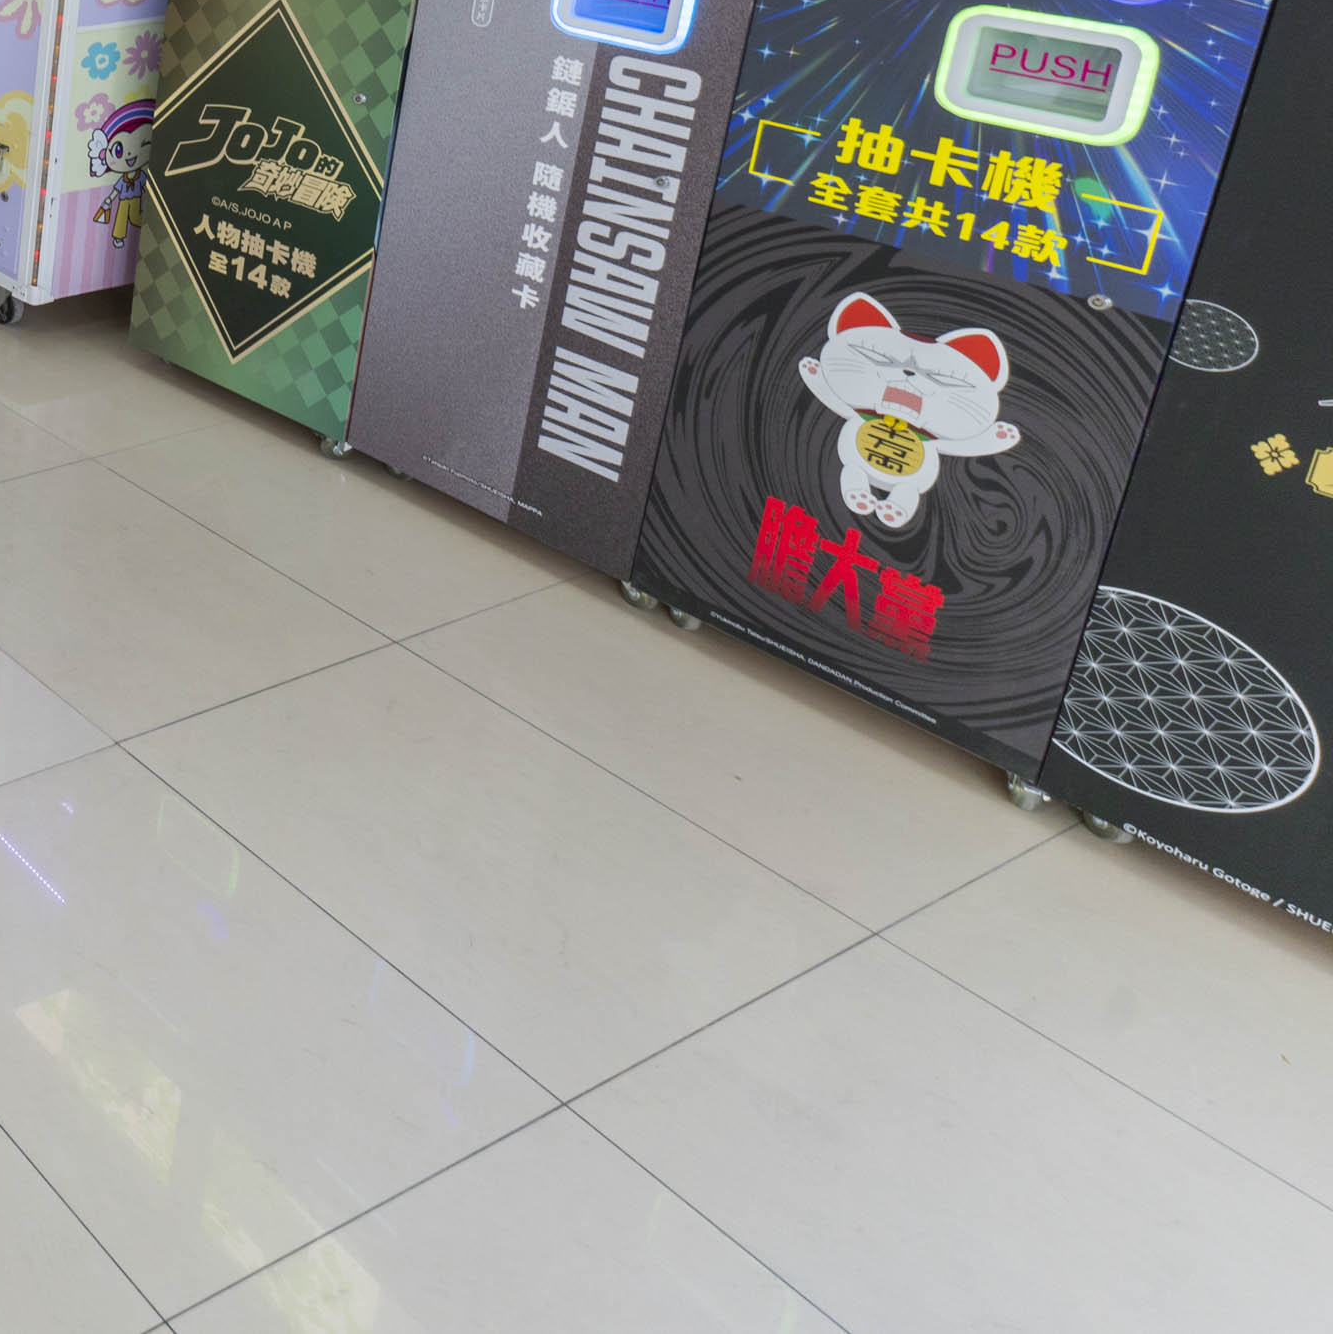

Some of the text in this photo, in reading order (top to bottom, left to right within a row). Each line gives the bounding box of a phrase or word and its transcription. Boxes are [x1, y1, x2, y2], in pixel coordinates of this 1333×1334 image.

[989, 43, 1113, 87] PUSH
[511, 56, 585, 311] 鏈鋸人 隨機收藏卡
[835, 116, 1063, 214] 抽卡機
[193, 213, 318, 279] 人物抽卡機
[808, 171, 1069, 267] 全套共14款
[208, 250, 292, 299] 全14款
[538, 56, 702, 483] CHAINSAW MAN
[807, 657, 853, 685] DANDADAN
[853, 679, 893, 704] Production
[894, 699, 937, 724] Committee
[1123, 822, 1209, 872] ©Koyoharu
[1212, 867, 1271, 903] Gotoge
[1286, 902, 1333, 934] SHUE
